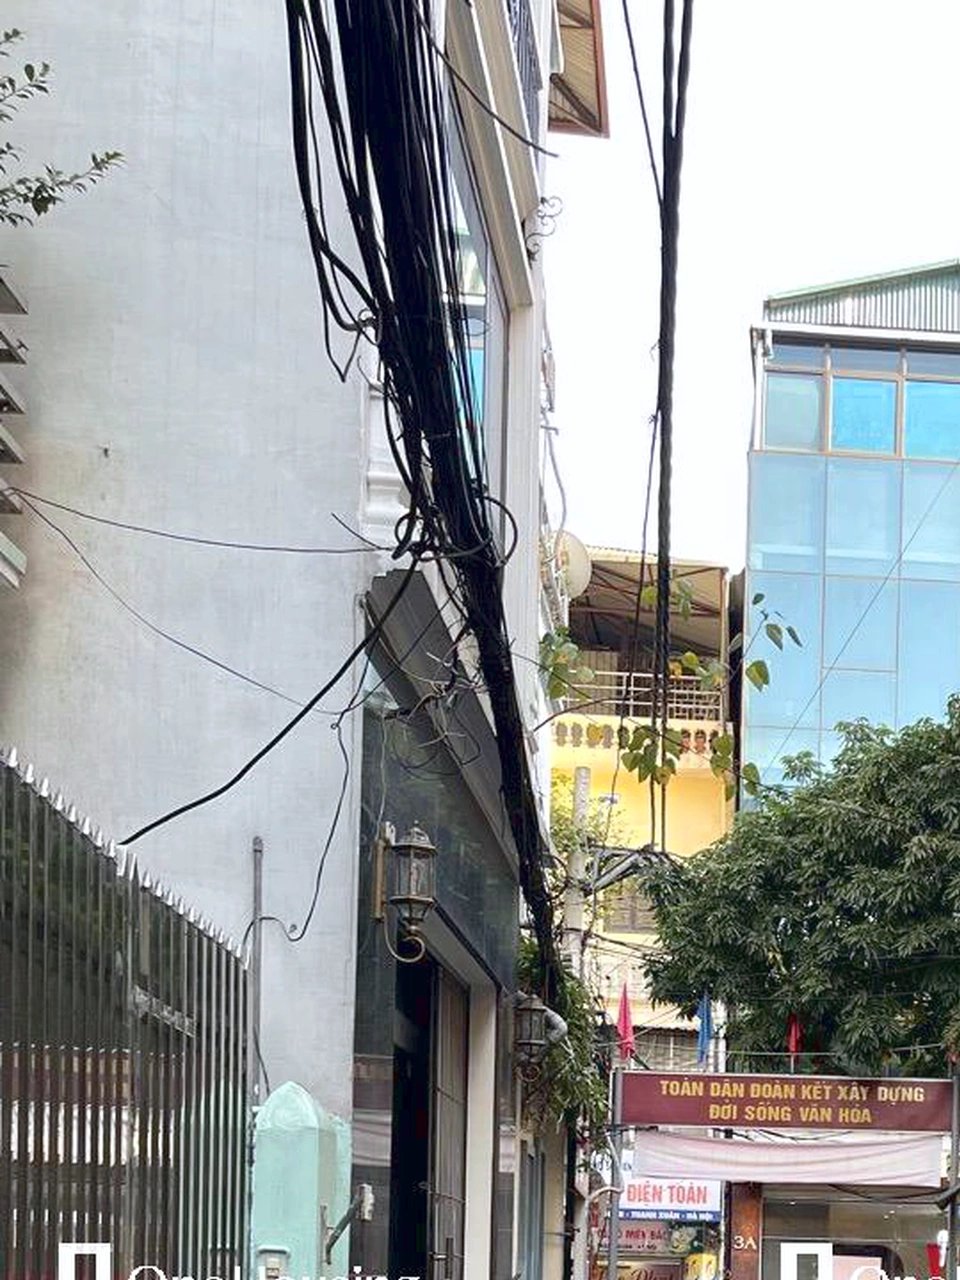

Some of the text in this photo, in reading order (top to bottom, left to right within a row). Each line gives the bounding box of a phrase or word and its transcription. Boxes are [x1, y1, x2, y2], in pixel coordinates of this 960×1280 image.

[661, 1077, 925, 1106] TOÀN DÂN ĐOÀN KẾT XÂY DỰNG
[709, 1100, 872, 1123] ĐỜI SỐNG VĂN HÓA
[734, 1236, 757, 1250] 3A
